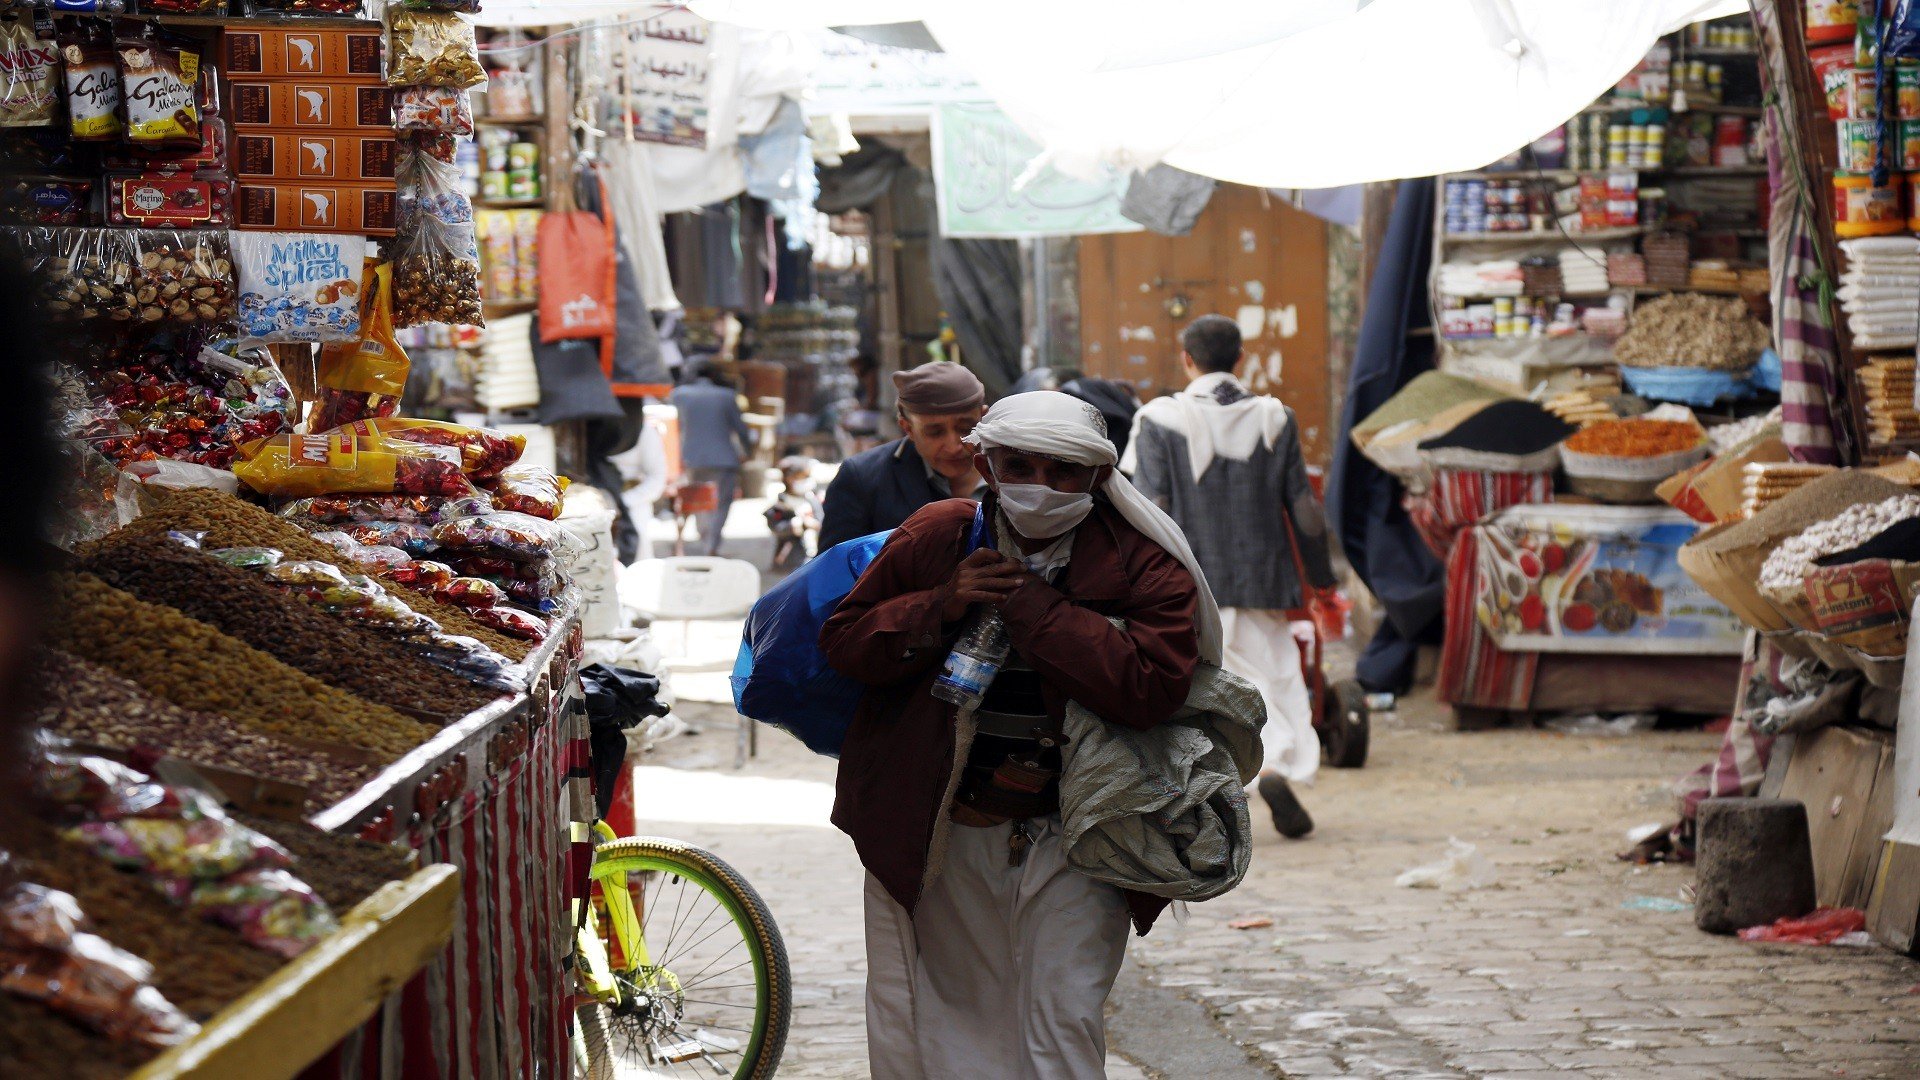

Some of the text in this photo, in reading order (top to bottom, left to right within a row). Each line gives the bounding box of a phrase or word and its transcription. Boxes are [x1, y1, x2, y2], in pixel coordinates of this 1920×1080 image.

[0, 43, 57, 72] wix
[68, 71, 119, 105] Gala
[126, 77, 194, 108] Galaxy
[96, 92, 119, 110] Mini
[155, 99, 181, 113] Minis
[145, 124, 178, 135] Caramel
[35, 190, 68, 201] جواهر
[135, 194, 162, 203] Marina
[271, 239, 340, 264] Milky
[264, 259, 349, 291] Splash
